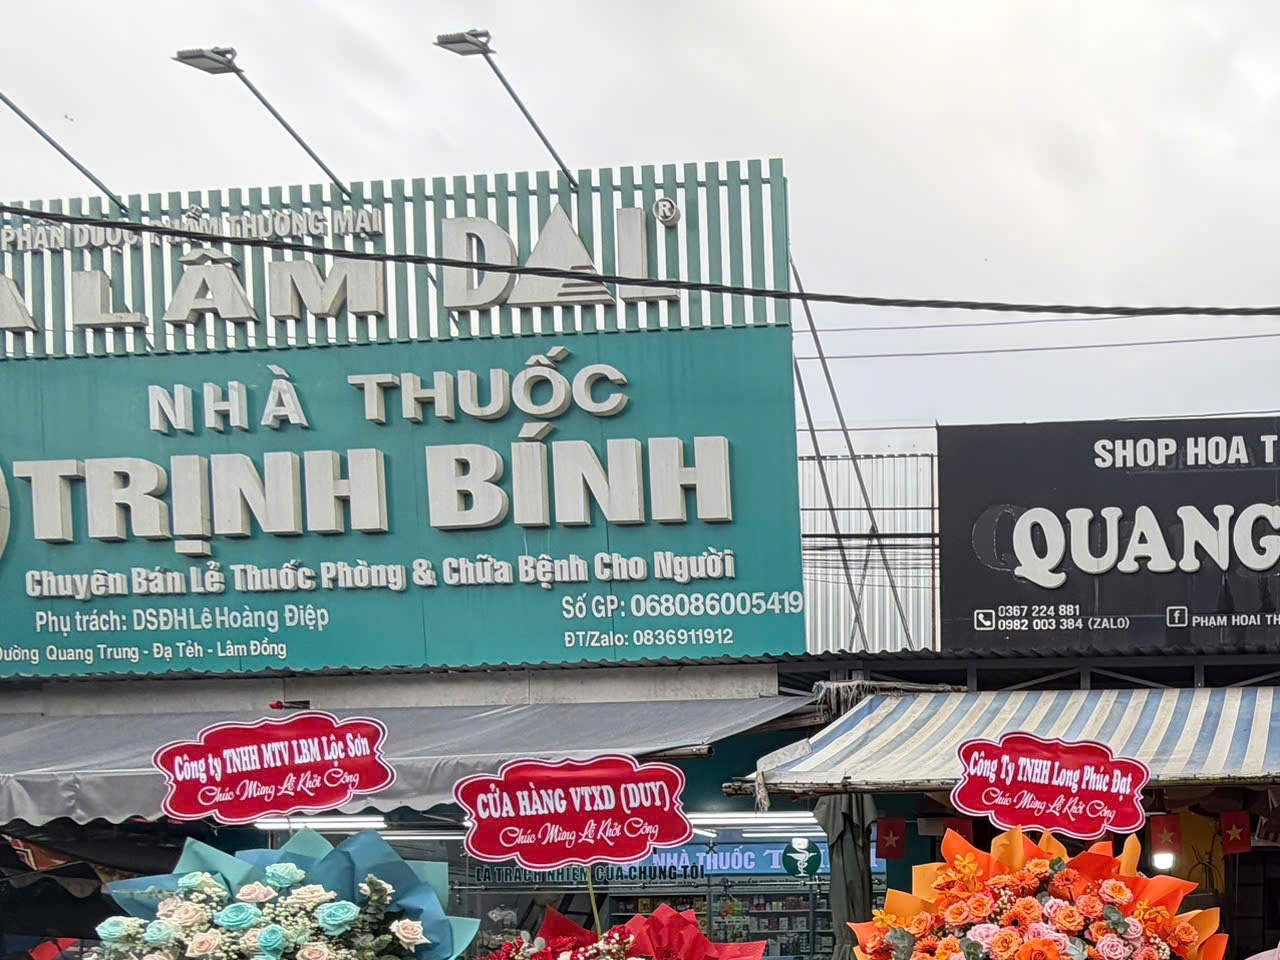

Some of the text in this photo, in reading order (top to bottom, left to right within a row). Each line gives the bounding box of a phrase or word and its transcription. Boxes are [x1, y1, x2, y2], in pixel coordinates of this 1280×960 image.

[228, 209, 327, 239] THƯƠNG
[333, 208, 384, 240] MẠI
[72, 247, 385, 328] LÂM
[148, 346, 629, 434] NHÀ THUỐC
[1094, 437, 1178, 468] SHOP
[1186, 435, 1249, 465] HOA
[13, 422, 733, 556] TRỊNH BÍNH
[26, 547, 736, 600] Chuyên Bán Lẻ Thuốc Phòng & Chữa Bệnh Cho Người
[35, 611, 71, 637] Phụ
[75, 609, 127, 632] trách:
[215, 604, 279, 632] Hoàng
[284, 603, 329, 631] Điệp
[562, 591, 803, 619] Số GP: 068086005419
[998, 604, 1080, 617] 0367 224 881
[632, 628, 734, 646] 0836911912
[998, 617, 1130, 630] 0982 003 384 (ZALO)
[1192, 616, 1227, 628] PHẠM
[0, 644, 39, 664] ường
[46, 645, 94, 664] Quang
[96, 644, 139, 662] Trung
[153, 643, 172, 658] Đạ
[217, 640, 247, 656] Lâm
[250, 637, 287, 658] Đồng
[175, 732, 370, 783] Công ty TNHH MTV LBM Lộc Sơn
[198, 768, 359, 805] Chúc Mừng Lễ Khởi Công
[969, 751, 1132, 802] Công Ty TNHH Long Phúc Đạt
[477, 781, 670, 819] CỬA HÀNG VTXD (DUY)
[982, 787, 1116, 824] Chúc Mừng Lễ Khởi Công
[500, 817, 658, 848] Chúc Mừng Lễ Khởi Công
[653, 848, 689, 869] NHÀ
[696, 846, 755, 869] THUỐC
